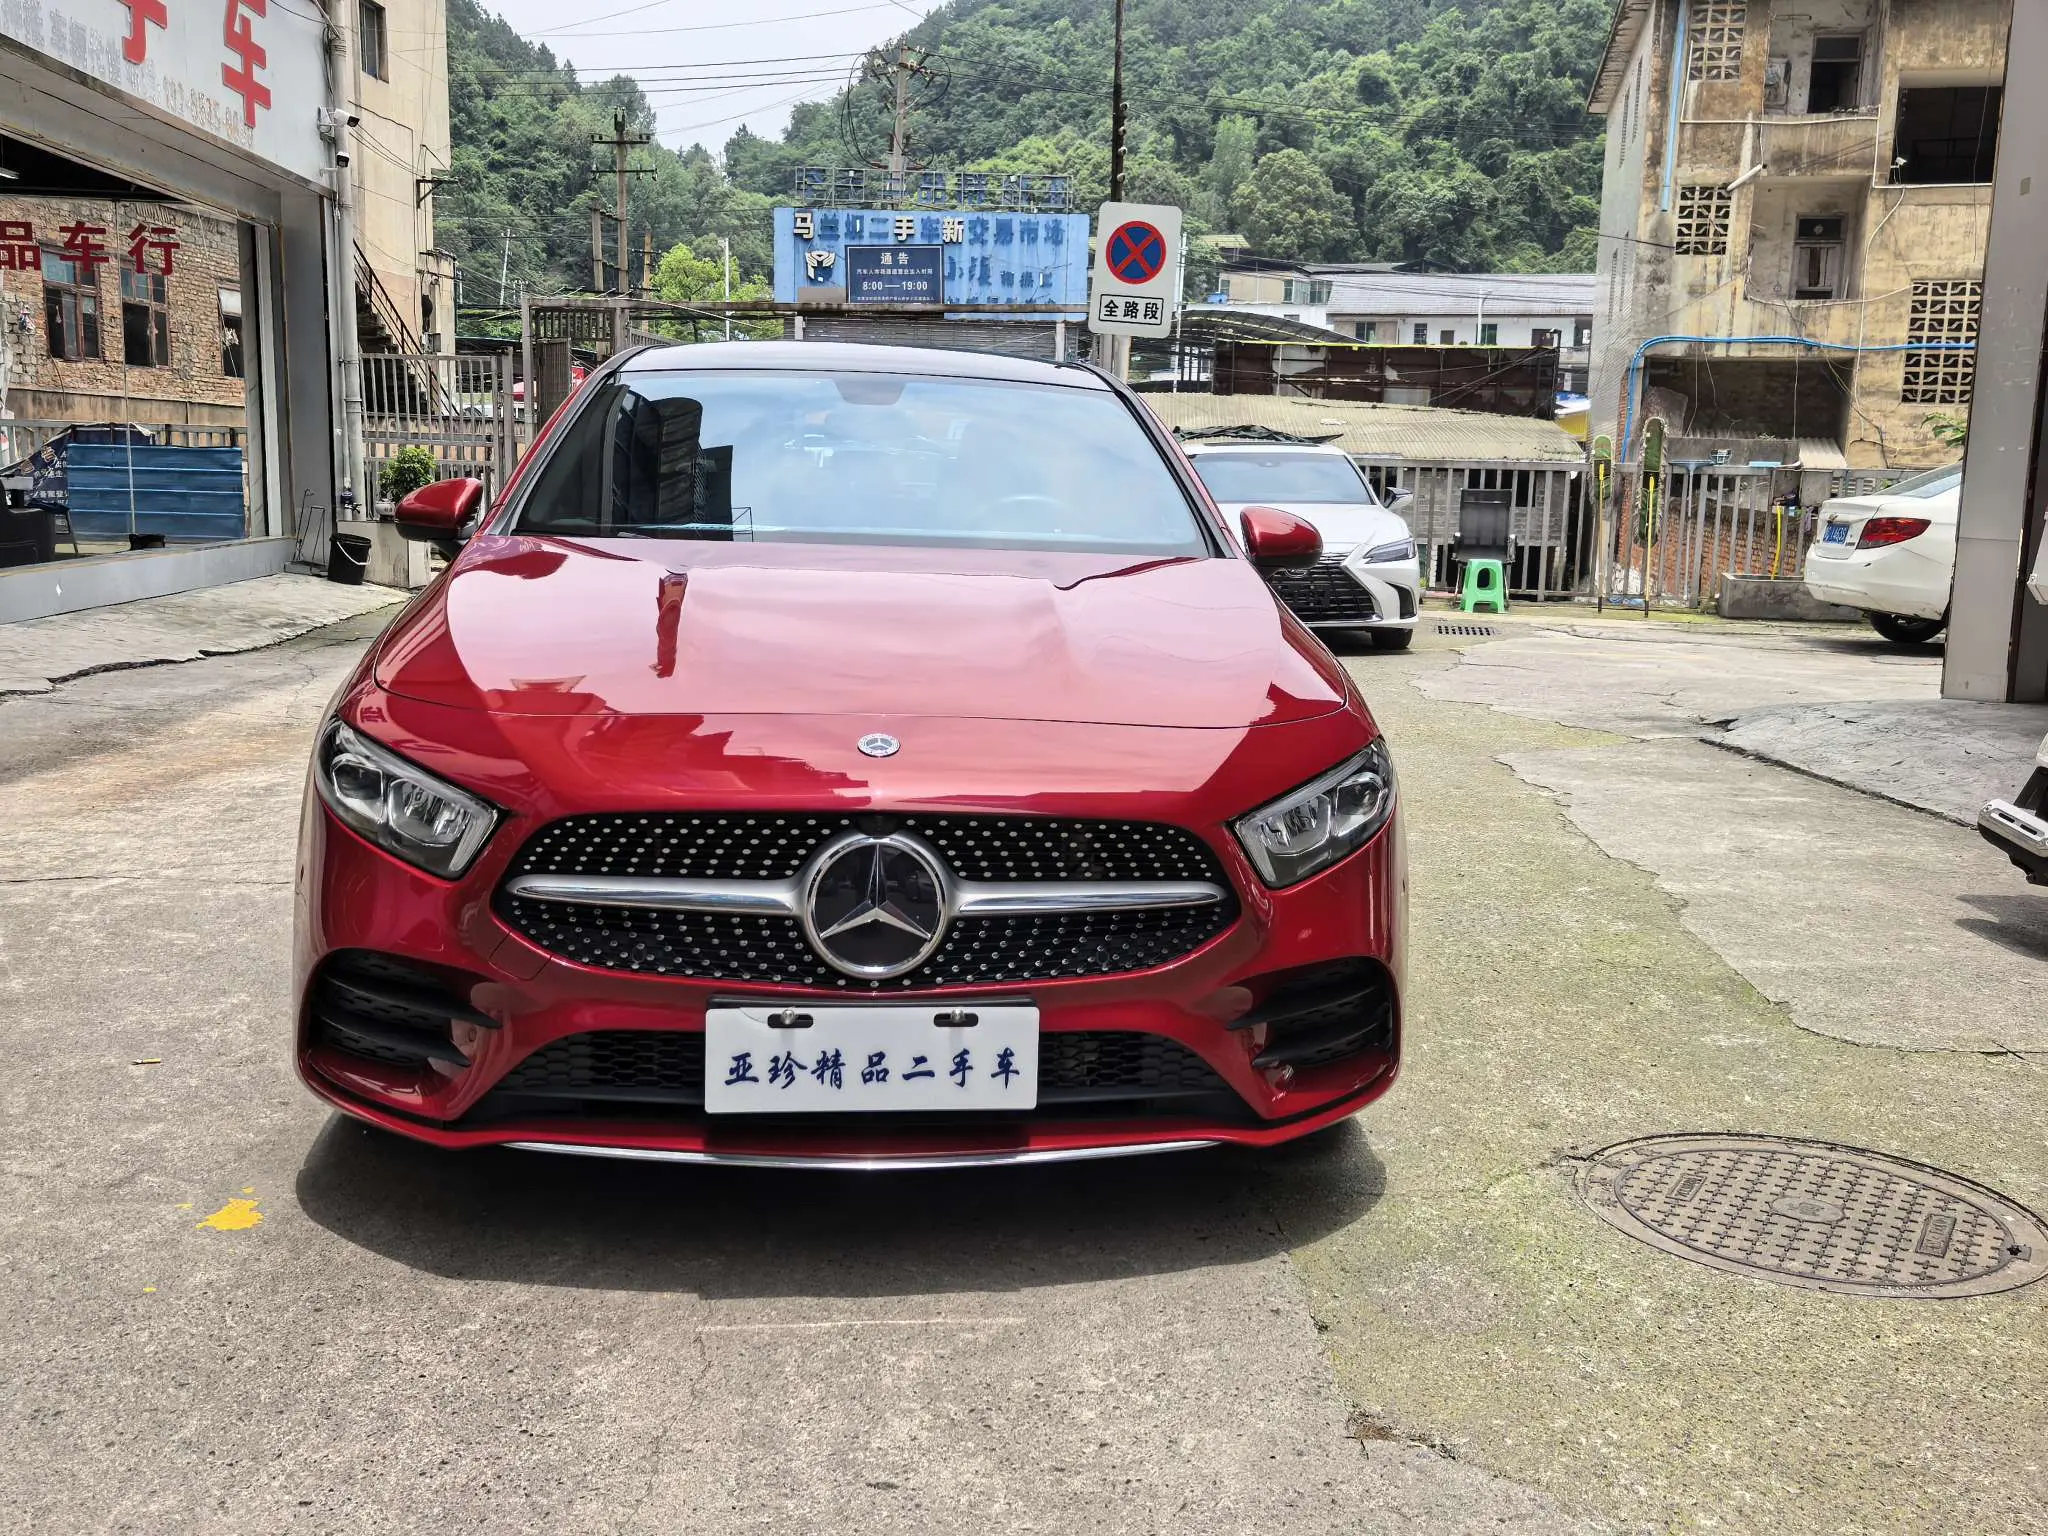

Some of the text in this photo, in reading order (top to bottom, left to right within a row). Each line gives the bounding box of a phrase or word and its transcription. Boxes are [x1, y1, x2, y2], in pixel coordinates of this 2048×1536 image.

[0, 220, 181, 276] 品车行
[880, 252, 910, 265] 通告
[1103, 299, 1160, 321] 全路段
[724, 1047, 1020, 1090] 亚珍精品二手车
